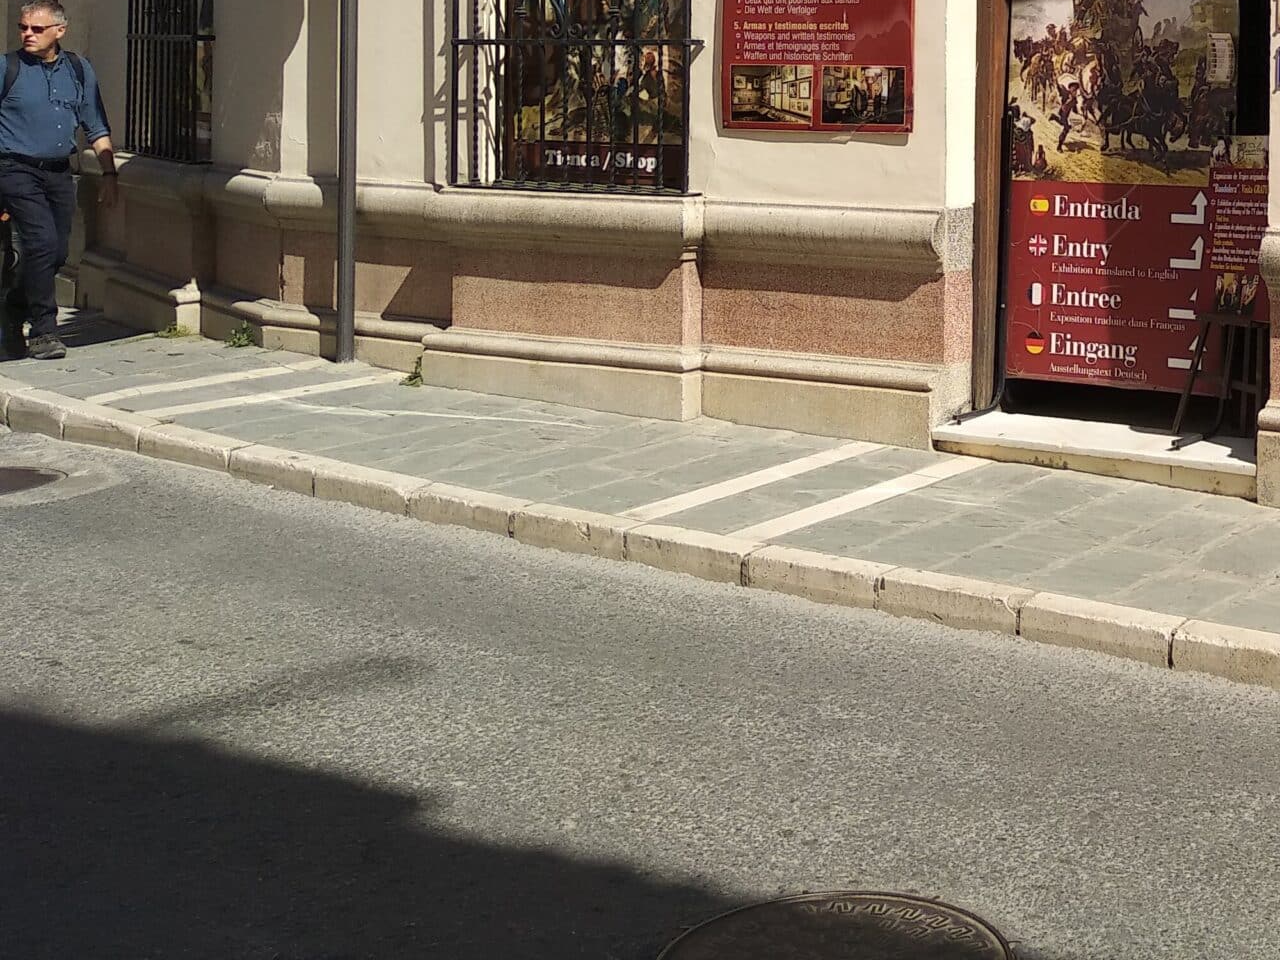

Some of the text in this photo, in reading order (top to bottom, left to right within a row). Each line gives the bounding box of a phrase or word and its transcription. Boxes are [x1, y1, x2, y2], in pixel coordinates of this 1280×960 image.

[745, 6, 755, 14] Die
[787, 6, 817, 15] Verfolger
[743, 22, 766, 30] Armas
[768, 23, 772, 31] y
[775, 21, 817, 30] testimonios
[819, 21, 849, 30] escritos
[744, 32, 775, 41] Weapons
[792, 32, 814, 40] written
[816, 31, 855, 40] testimonies
[744, 41, 839, 51] Armes et témoignages écrits
[744, 52, 767, 60] Waffen
[783, 52, 821, 60] historische
[823, 52, 853, 60] Schriften
[615, 152, 657, 172] Shop
[1053, 194, 1141, 221] Entrada
[1052, 234, 1112, 265] Entry
[1051, 262, 1178, 281] Exhibition translated to English
[1050, 284, 1121, 309] Entree
[1050, 311, 1185, 333] Exposition traduite dans Français
[1049, 332, 1138, 367] Eingang
[1049, 363, 1147, 381] Ausstellungstext Deutsch
